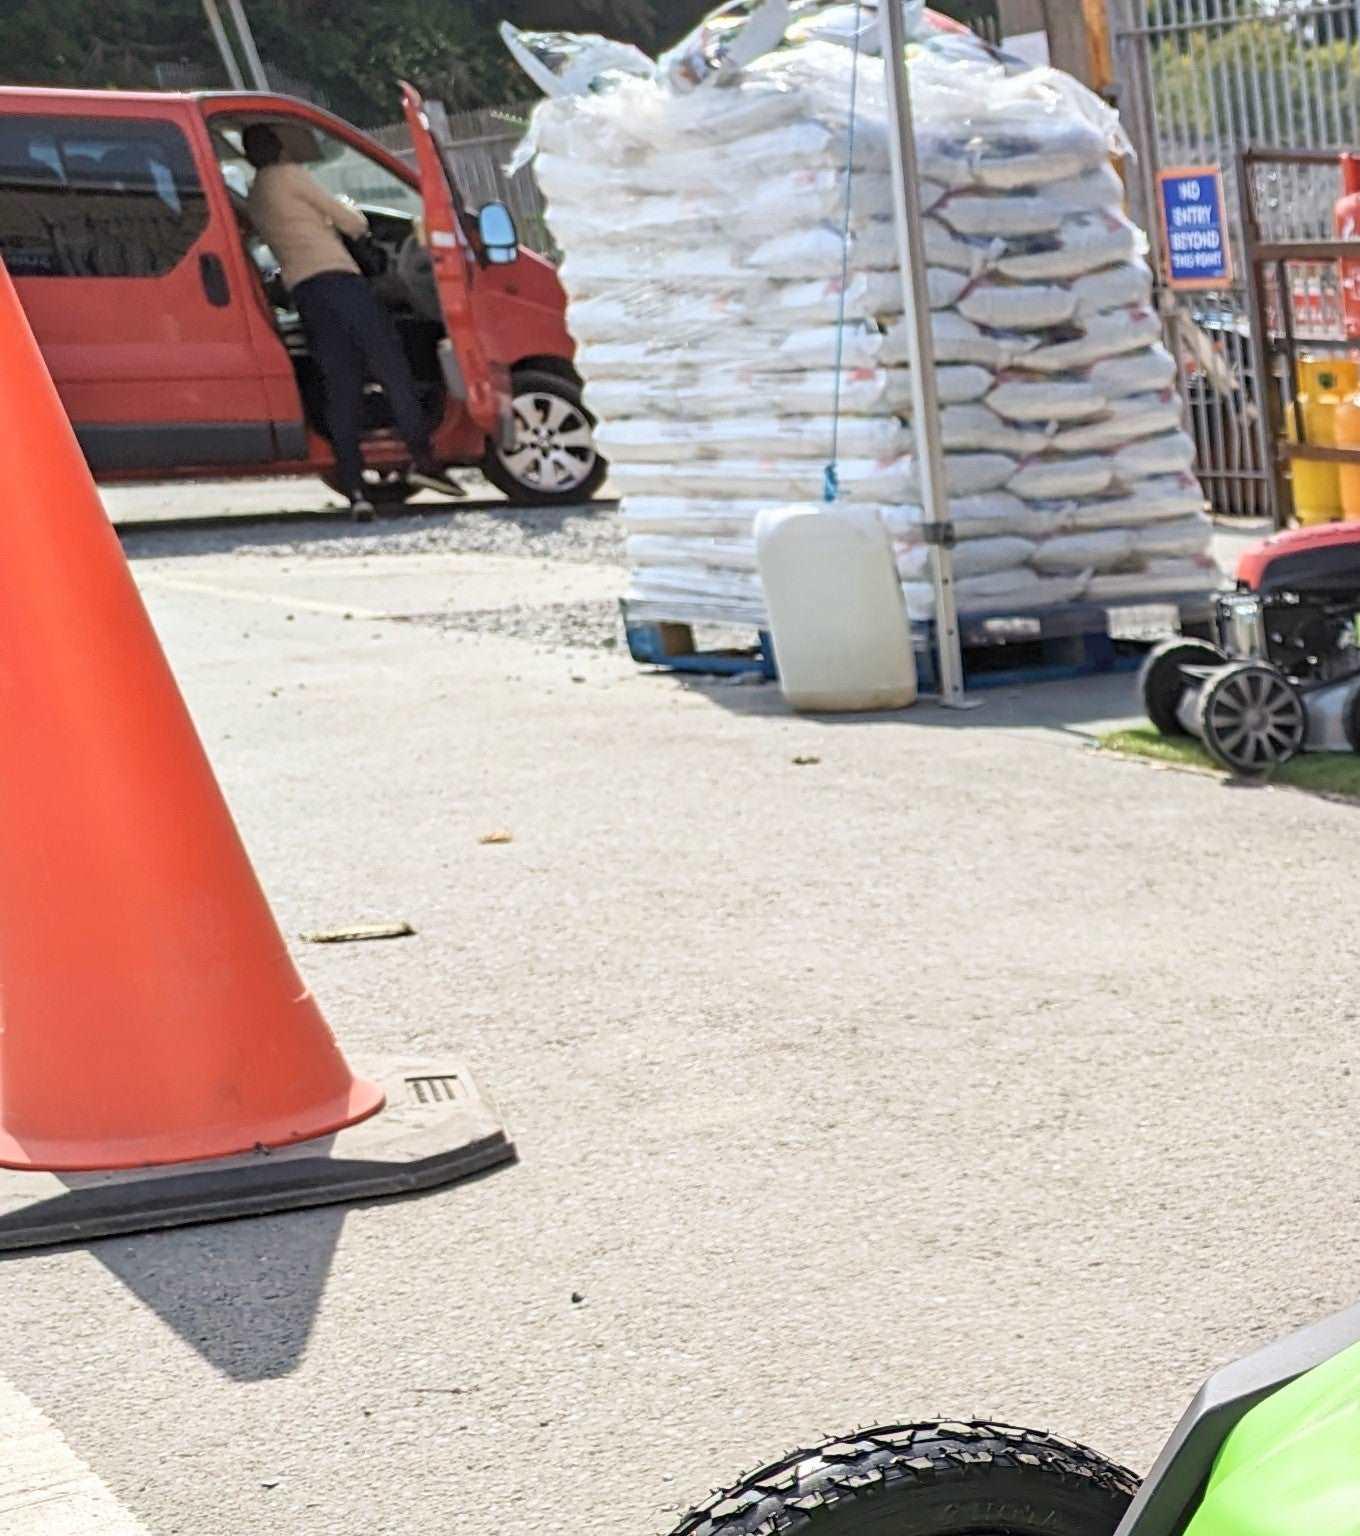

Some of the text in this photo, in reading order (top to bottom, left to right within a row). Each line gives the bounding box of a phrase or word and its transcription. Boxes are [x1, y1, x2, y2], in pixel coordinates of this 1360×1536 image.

[1177, 180, 1201, 201] NO
[1171, 205, 1212, 226] ENTRY
[1170, 230, 1220, 251] BEYOND
[1172, 251, 1222, 269] THIS POINT
